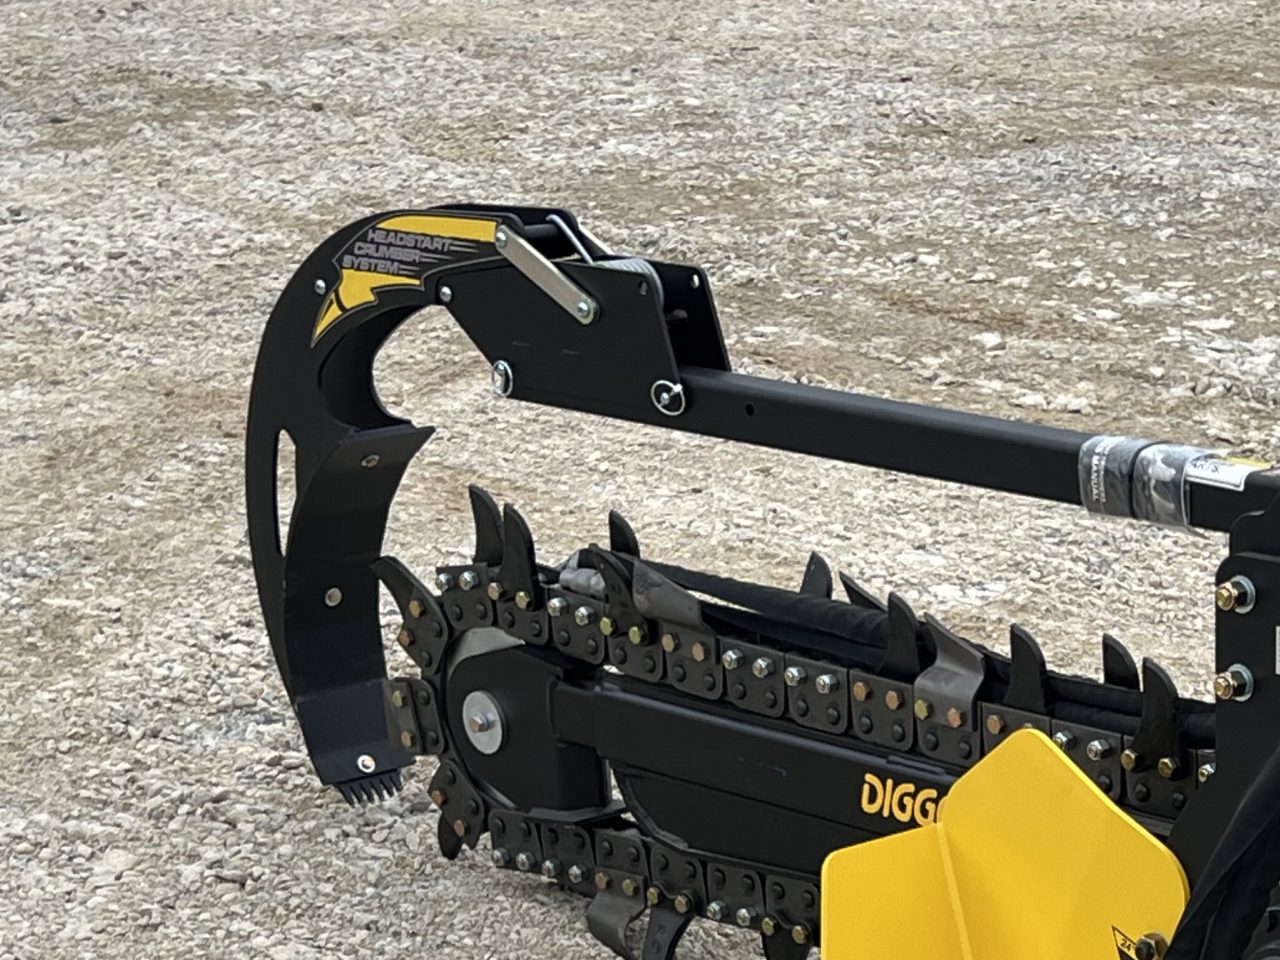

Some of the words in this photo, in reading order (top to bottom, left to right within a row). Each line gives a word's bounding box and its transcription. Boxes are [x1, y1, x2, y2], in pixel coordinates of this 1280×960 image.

[353, 241, 421, 263] CRUMBER
[366, 230, 451, 252] HEADSTART
[342, 255, 400, 275] SYSTEM
